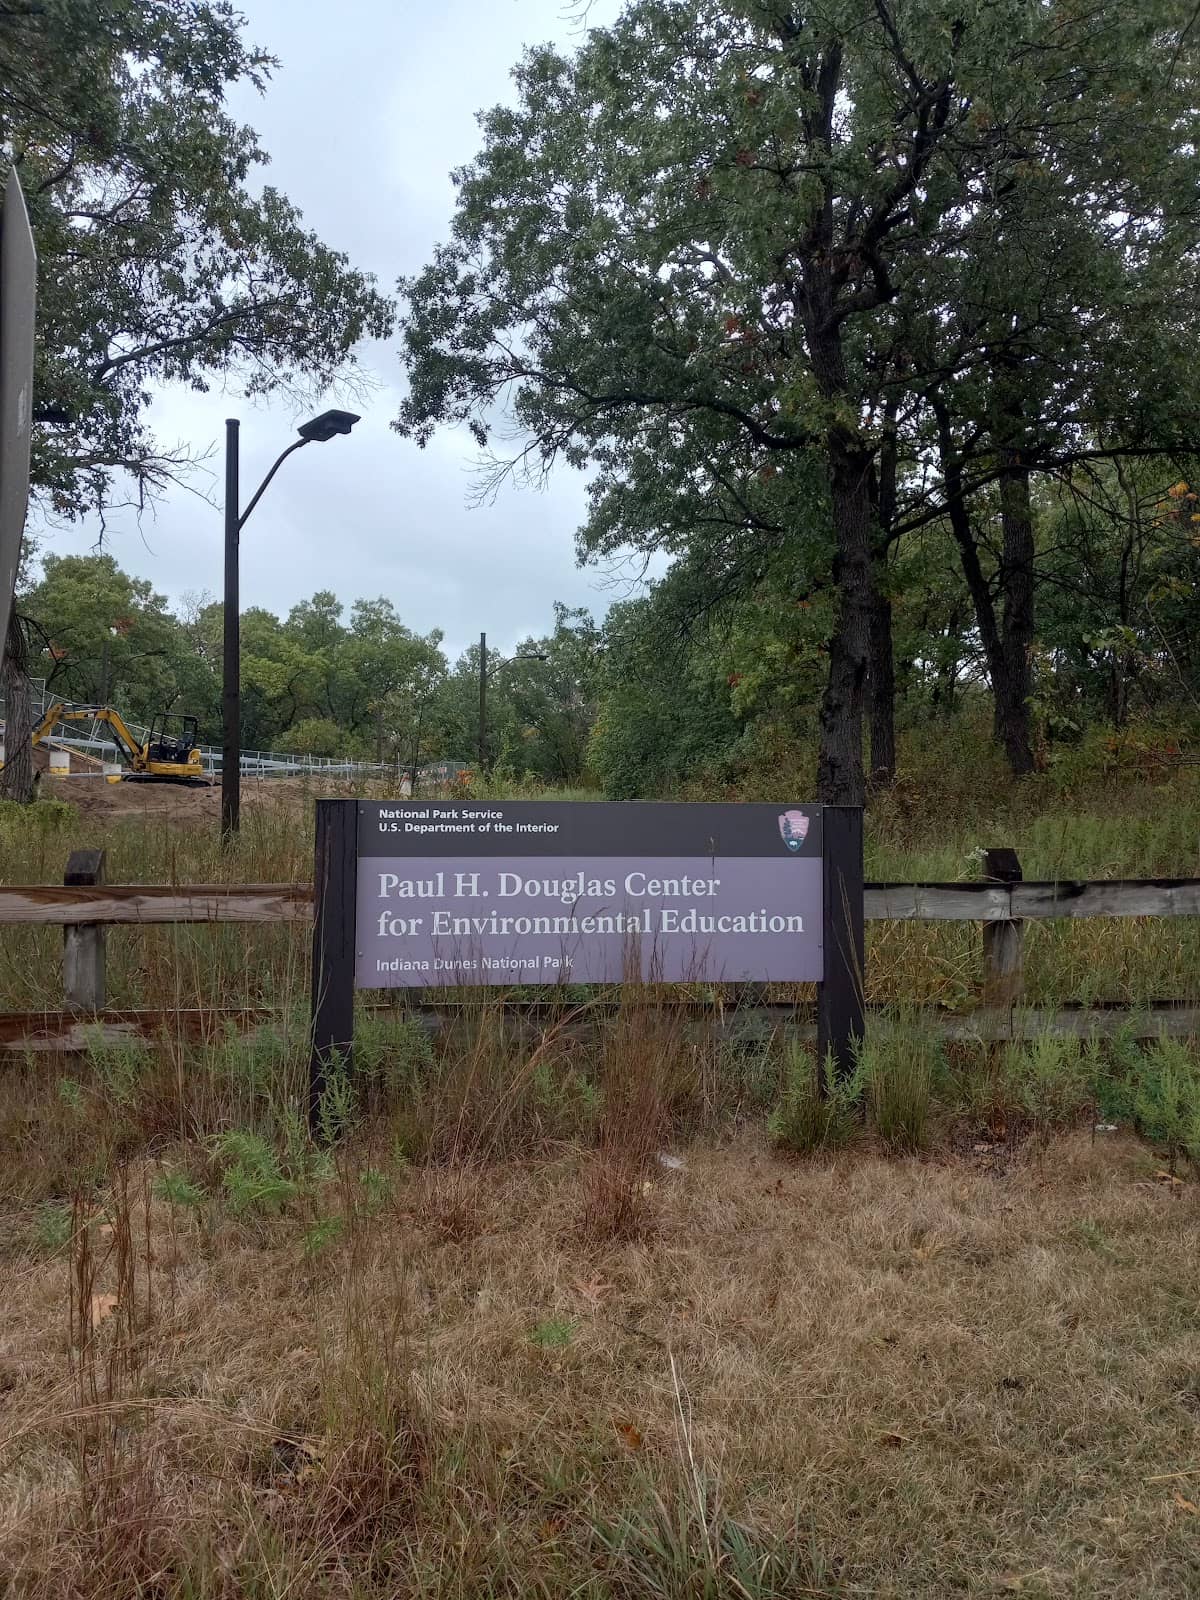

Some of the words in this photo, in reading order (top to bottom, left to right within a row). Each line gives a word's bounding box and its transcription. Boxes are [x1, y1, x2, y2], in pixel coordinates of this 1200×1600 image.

[378, 809, 430, 819] National
[432, 809, 459, 819] Park
[461, 809, 503, 819] Service
[378, 823, 401, 833] U.S.
[404, 823, 475, 835] Department
[478, 823, 490, 833] of
[494, 823, 513, 833] the
[516, 823, 559, 833] Interior
[378, 872, 444, 898] Paul
[454, 872, 489, 897] H.
[497, 871, 616, 904] Douglas
[624, 872, 720, 897] Center
[377, 911, 423, 937] for
[431, 909, 652, 937] Environmental
[659, 908, 805, 934] Education
[376, 957, 430, 972] Indiana
[434, 957, 478, 971] Dunes
[481, 956, 541, 970] National
